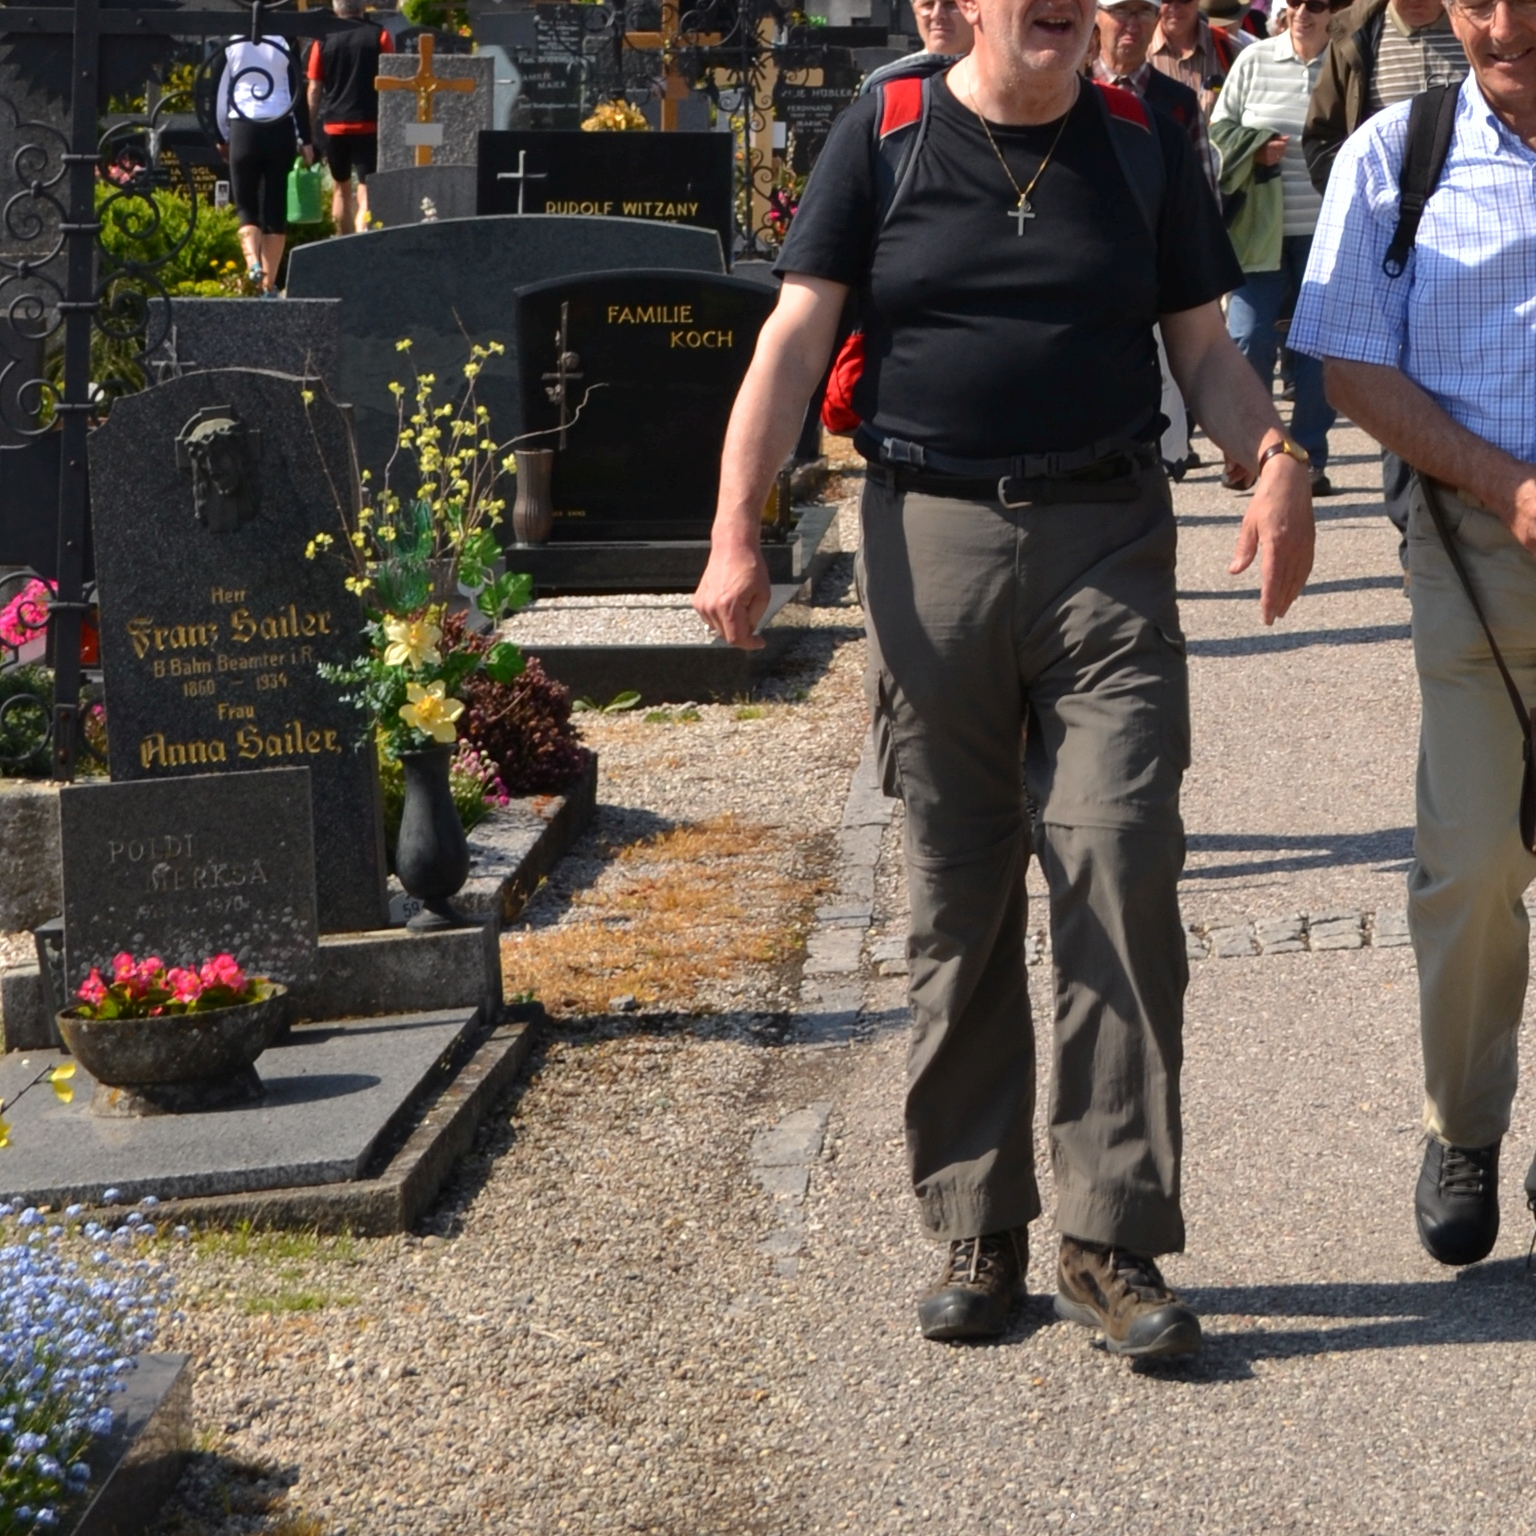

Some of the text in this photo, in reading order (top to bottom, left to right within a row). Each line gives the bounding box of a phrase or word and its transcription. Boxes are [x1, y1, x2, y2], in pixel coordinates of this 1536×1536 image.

[545, 201, 699, 217] RUDOLF WITZANY
[607, 304, 694, 324] FAMILIE
[669, 329, 733, 349] KOCH
[210, 586, 247, 604] Herr
[127, 616, 218, 660] Franz
[216, 649, 285, 672] Beamter
[182, 678, 216, 698] 1860
[255, 672, 289, 692] 1934
[216, 702, 256, 721] Frau
[139, 730, 228, 770] Anna
[402, 901, 421, 919] 59
